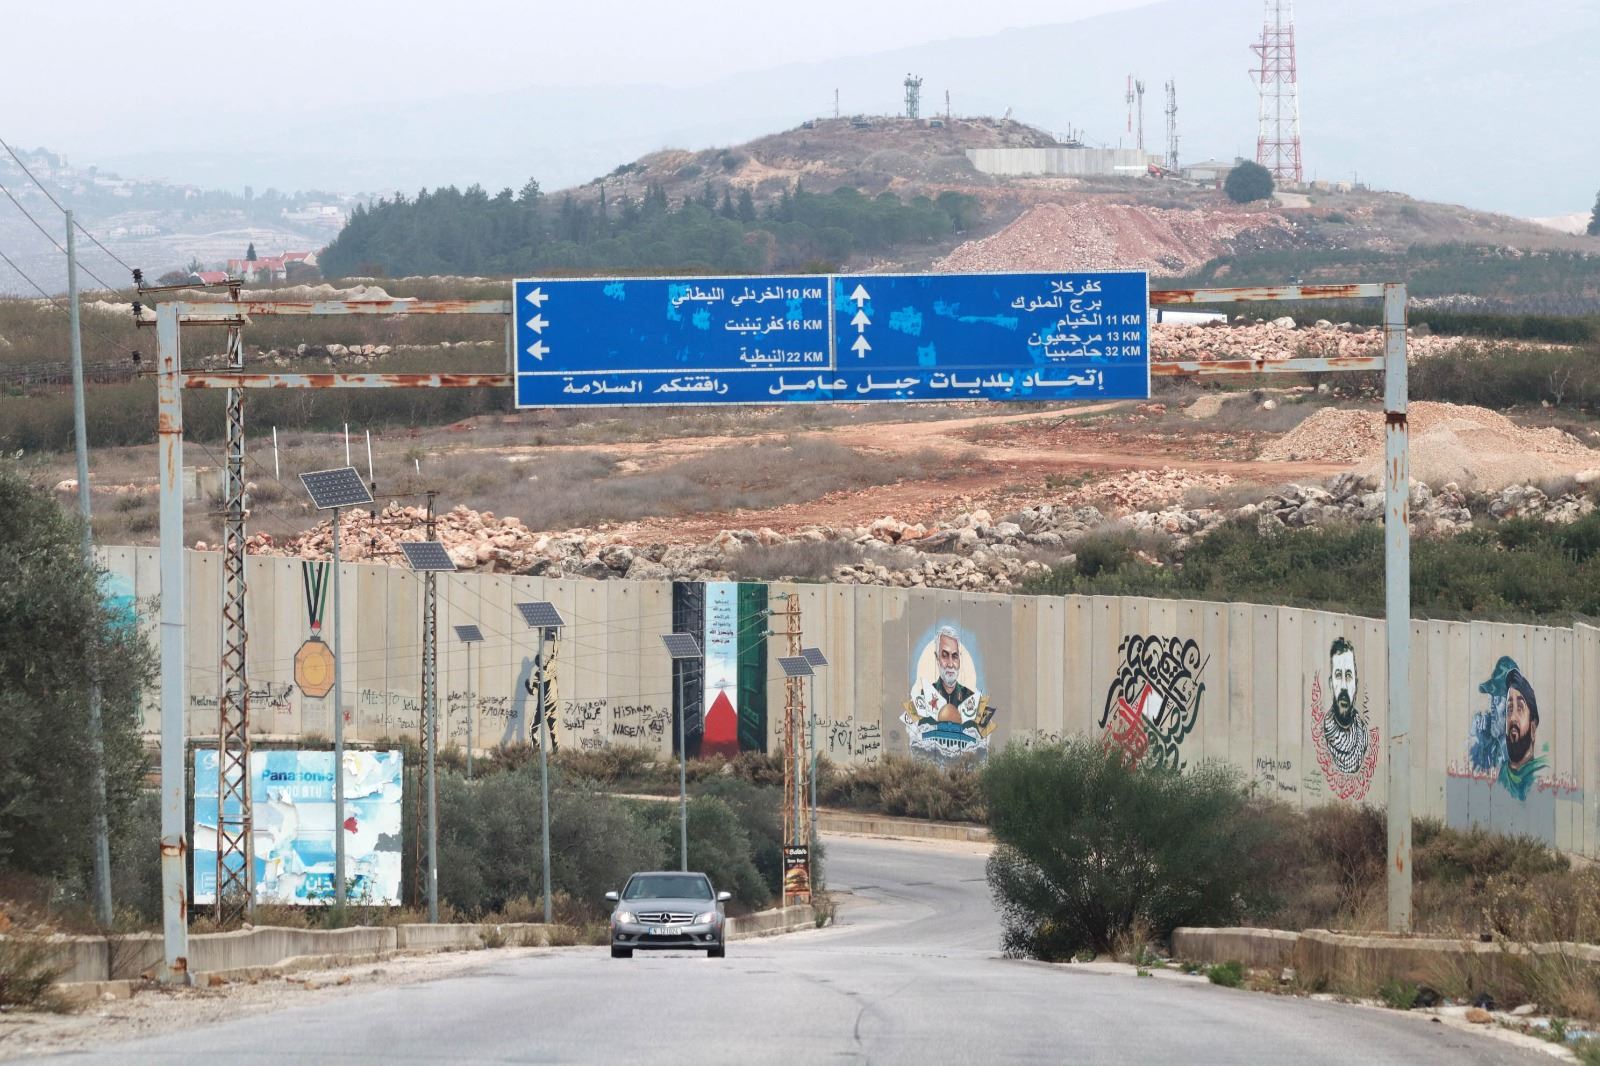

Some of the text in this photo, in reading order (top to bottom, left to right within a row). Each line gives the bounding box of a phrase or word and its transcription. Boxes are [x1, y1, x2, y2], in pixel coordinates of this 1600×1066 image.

[671, 286, 822, 308] الخردلي الليطاني 10 KM
[1011, 295, 1102, 313] برج الملوك
[786, 320, 800, 330] 16
[803, 319, 823, 330] KM
[1056, 313, 1140, 330] الخيام 11 KM
[1027, 331, 1141, 346] مرجعيون 13 KM
[739, 347, 823, 368] النبطية 22 KM
[1044, 344, 1141, 361] حاصبيا 32 KM
[562, 369, 1104, 395] إتحاد بلديات جبل عامل رافقتكم السلامة
[262, 769, 334, 781] Panaonic
